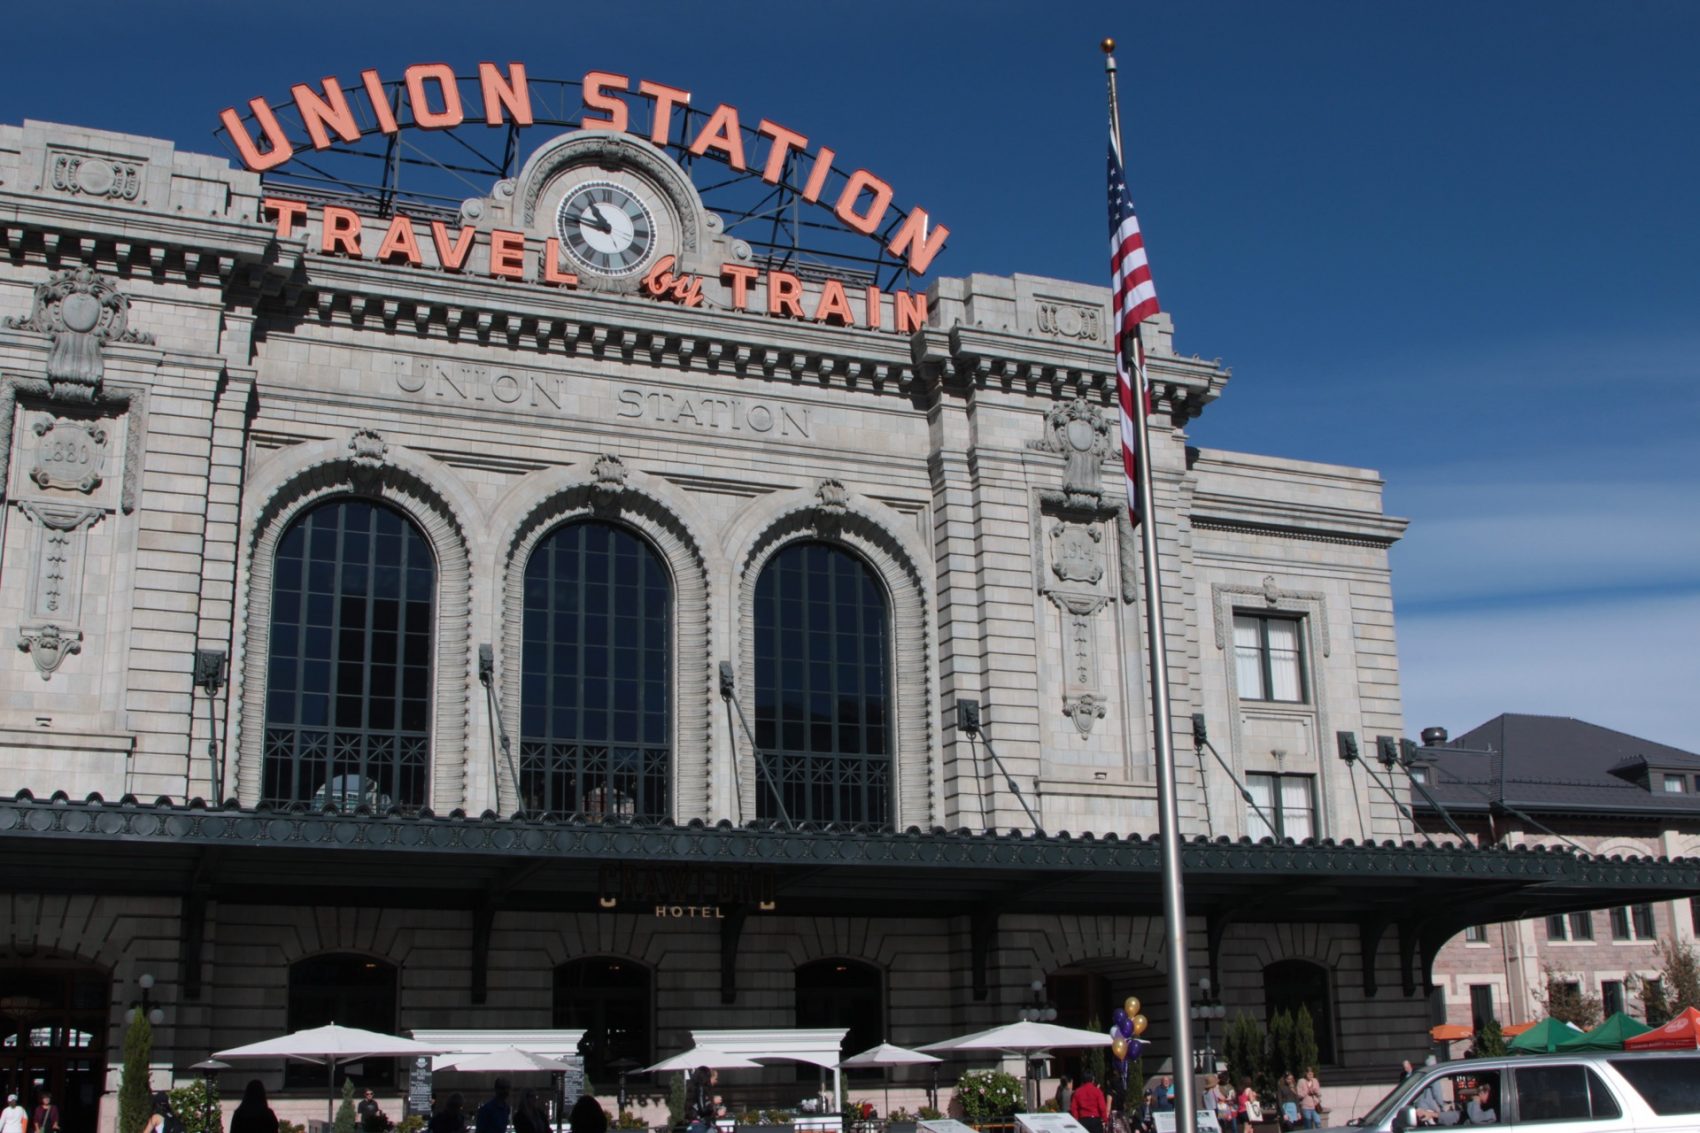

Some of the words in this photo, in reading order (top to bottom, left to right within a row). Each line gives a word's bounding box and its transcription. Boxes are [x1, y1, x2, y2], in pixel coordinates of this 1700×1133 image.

[219, 62, 533, 172] UNION
[581, 70, 950, 276] STATION
[263, 197, 578, 287] TRAVEL
[640, 255, 704, 307] by
[720, 262, 928, 333] TRAIN
[393, 360, 565, 410] UNION
[616, 388, 812, 439] STATION
[655, 905, 726, 919] HOTEL
